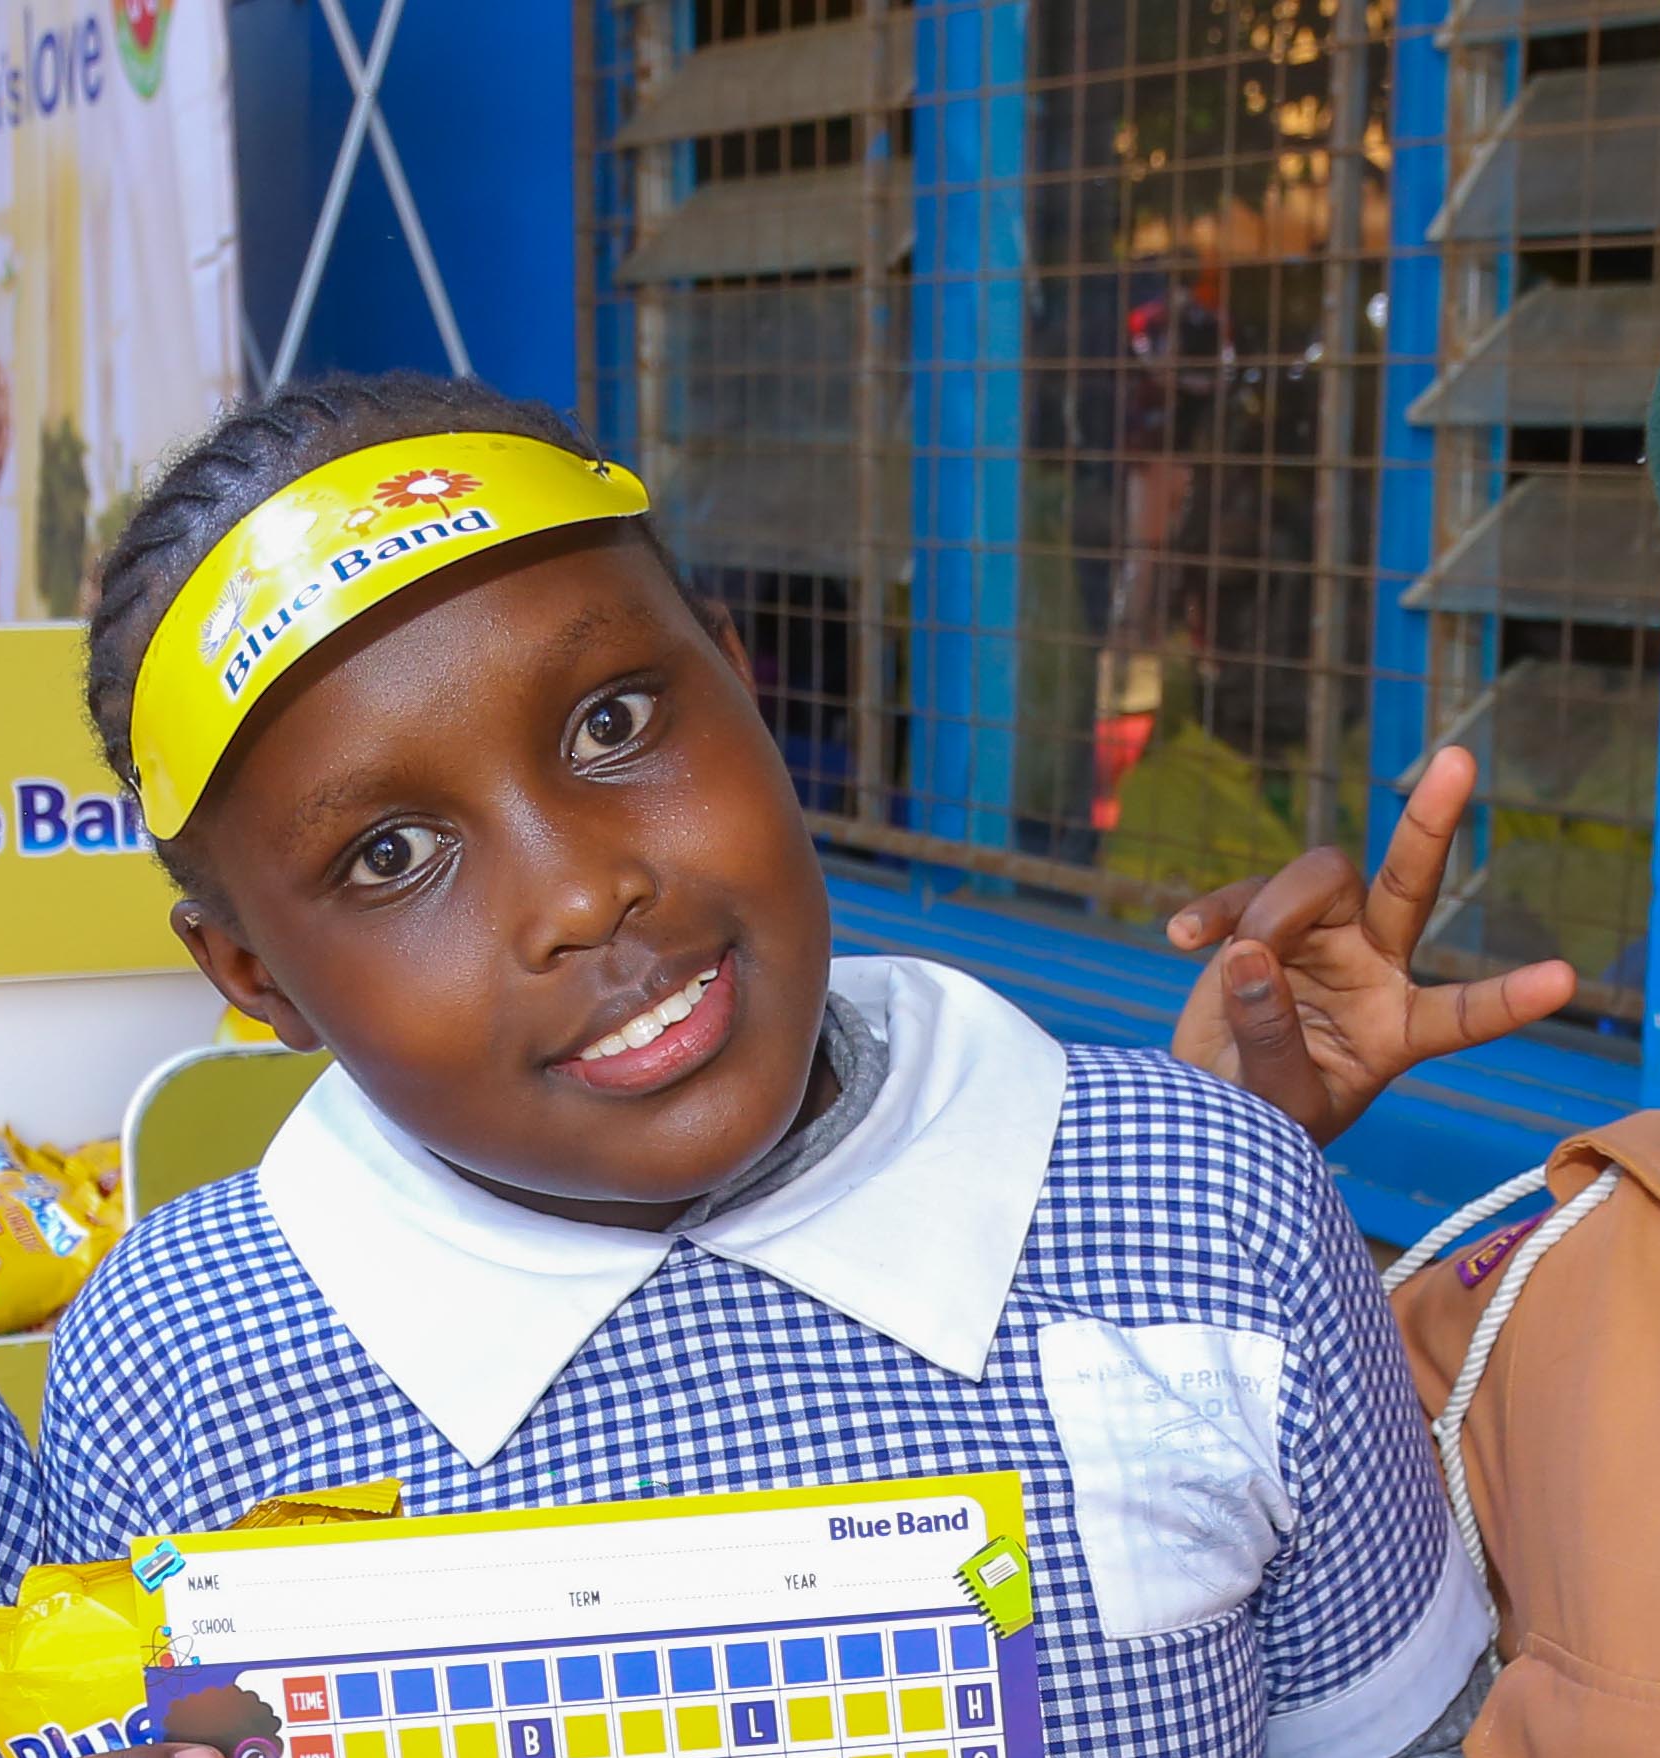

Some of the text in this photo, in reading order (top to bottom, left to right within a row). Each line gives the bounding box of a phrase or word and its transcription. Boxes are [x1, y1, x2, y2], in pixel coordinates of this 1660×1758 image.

[24, 6, 103, 118] love
[225, 510, 491, 697] Blue Band
[828, 1507, 969, 1541] Blue Band
[187, 1573, 221, 1592] NAME
[784, 1573, 818, 1591] YEAR
[568, 1590, 601, 1609] TERM
[191, 1617, 237, 1637] SCHOOL
[290, 1691, 325, 1713] TIME
